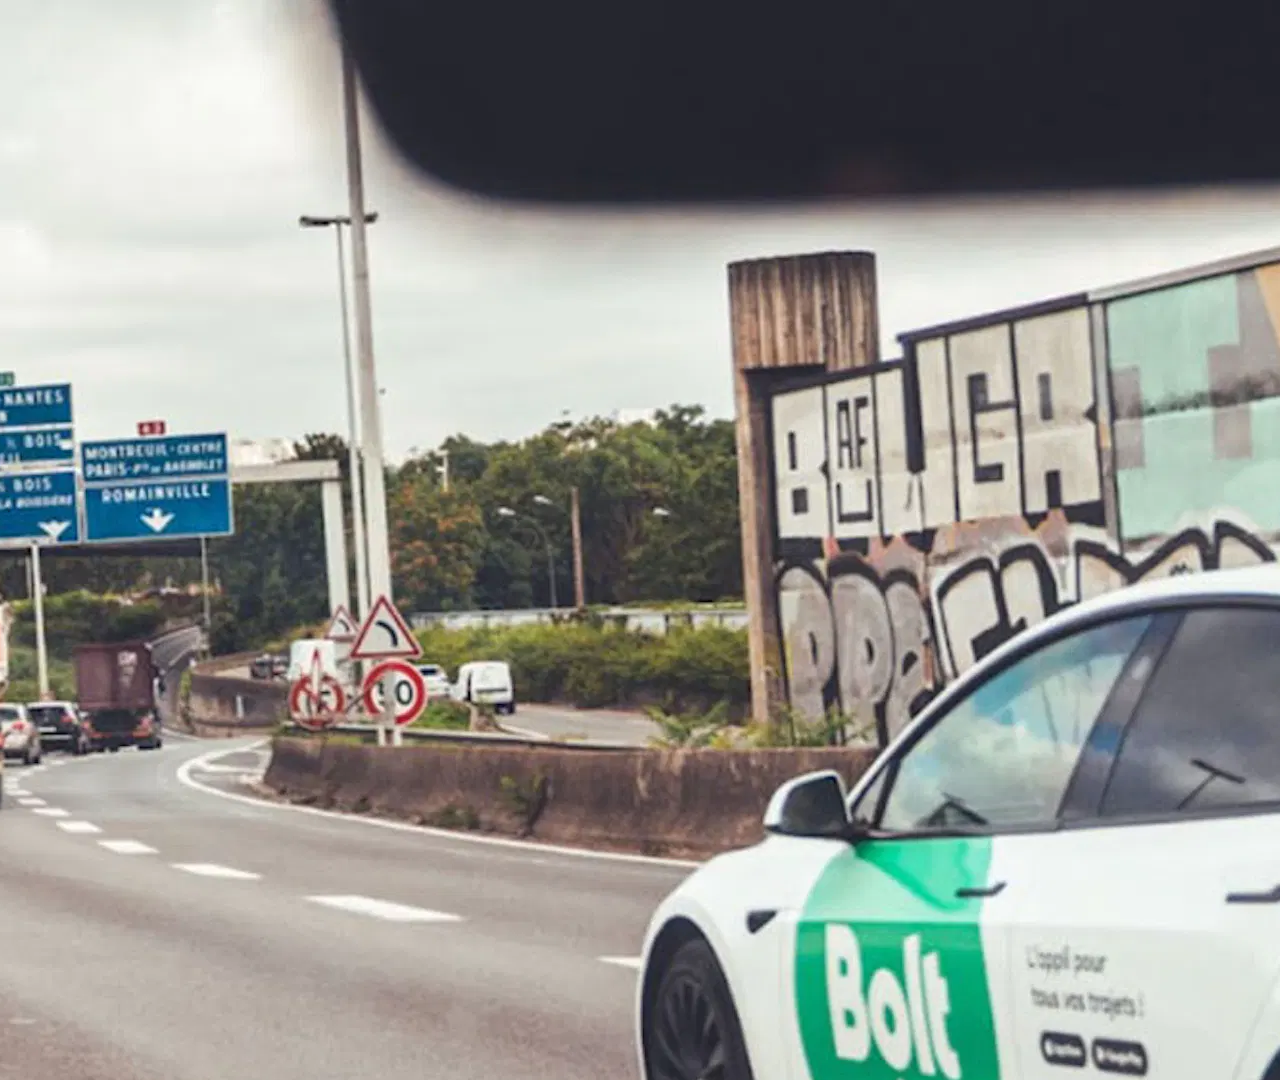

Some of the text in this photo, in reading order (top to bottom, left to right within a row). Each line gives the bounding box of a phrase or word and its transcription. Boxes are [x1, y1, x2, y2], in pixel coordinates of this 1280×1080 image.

[23, 432, 62, 449] BOIS
[12, 476, 53, 493] BOIS
[101, 482, 212, 504] ROMAINVILLE
[1073, 952, 1109, 980] pour
[1030, 984, 1060, 1010] tous
[1063, 991, 1086, 1013] vos
[1087, 988, 1136, 1022] trajets
